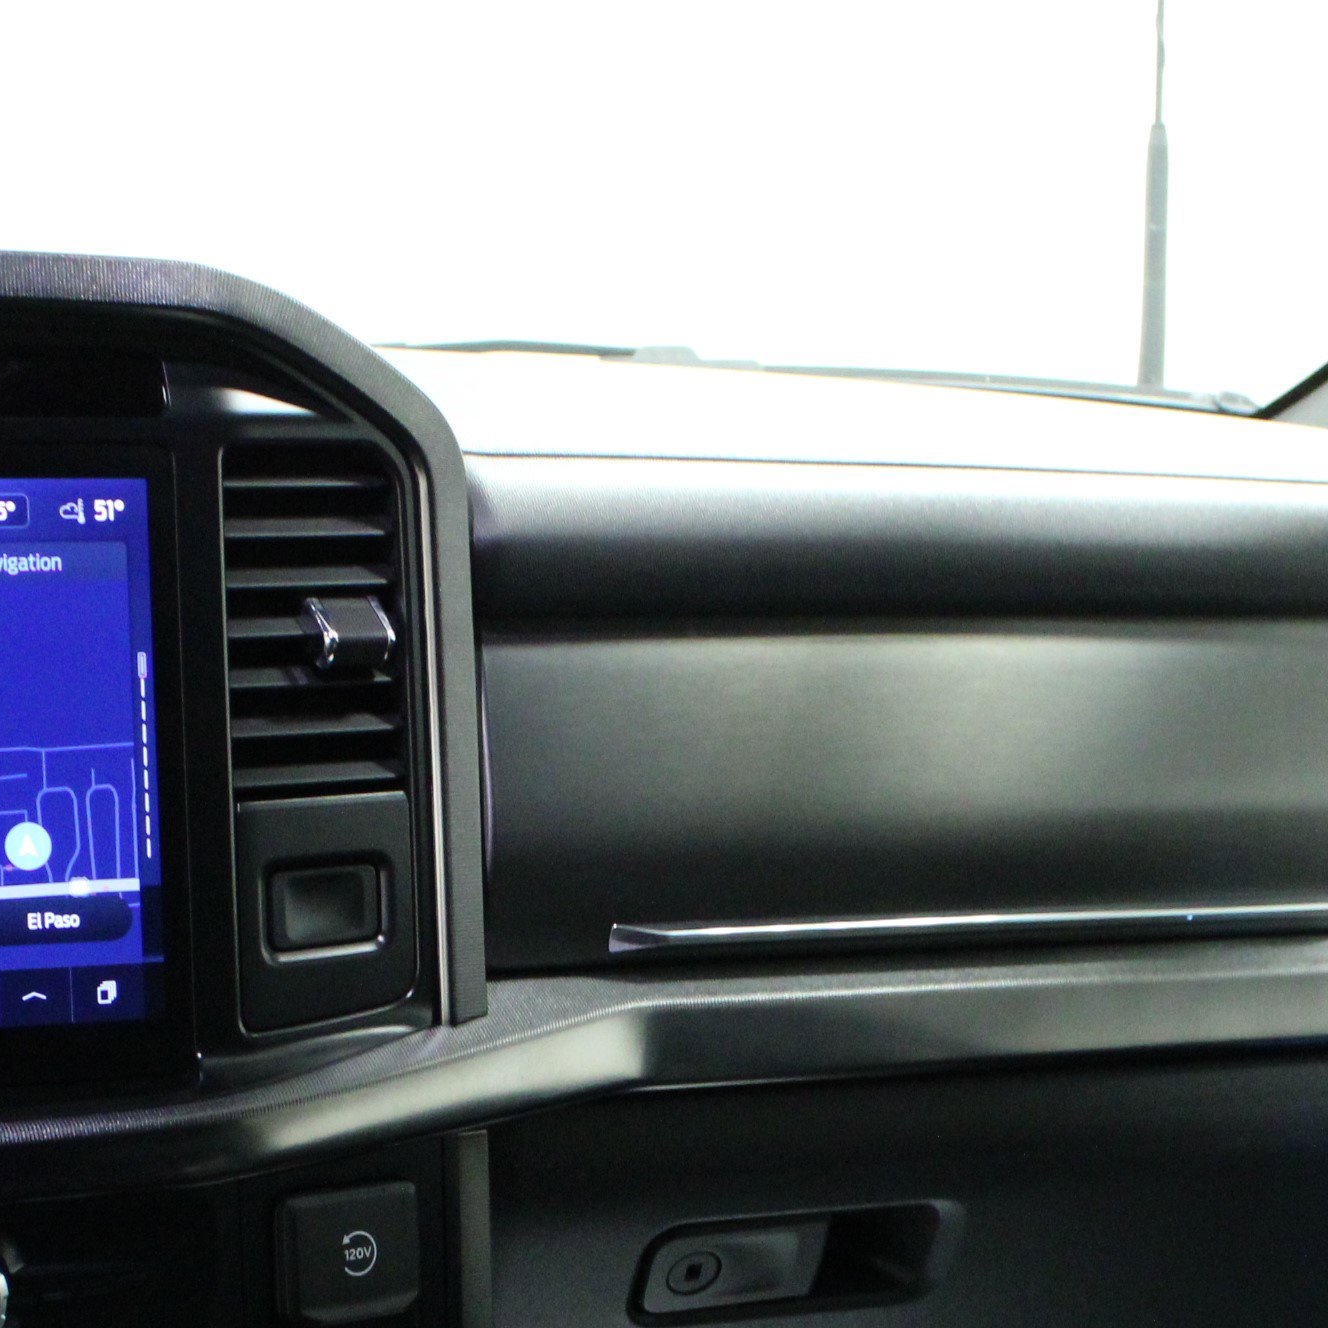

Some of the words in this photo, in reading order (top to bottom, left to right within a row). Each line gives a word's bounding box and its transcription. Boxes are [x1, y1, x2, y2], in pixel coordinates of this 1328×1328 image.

[27, 913, 42, 930] El
[44, 912, 81, 929] Paso
[344, 1245, 372, 1261] 120V
